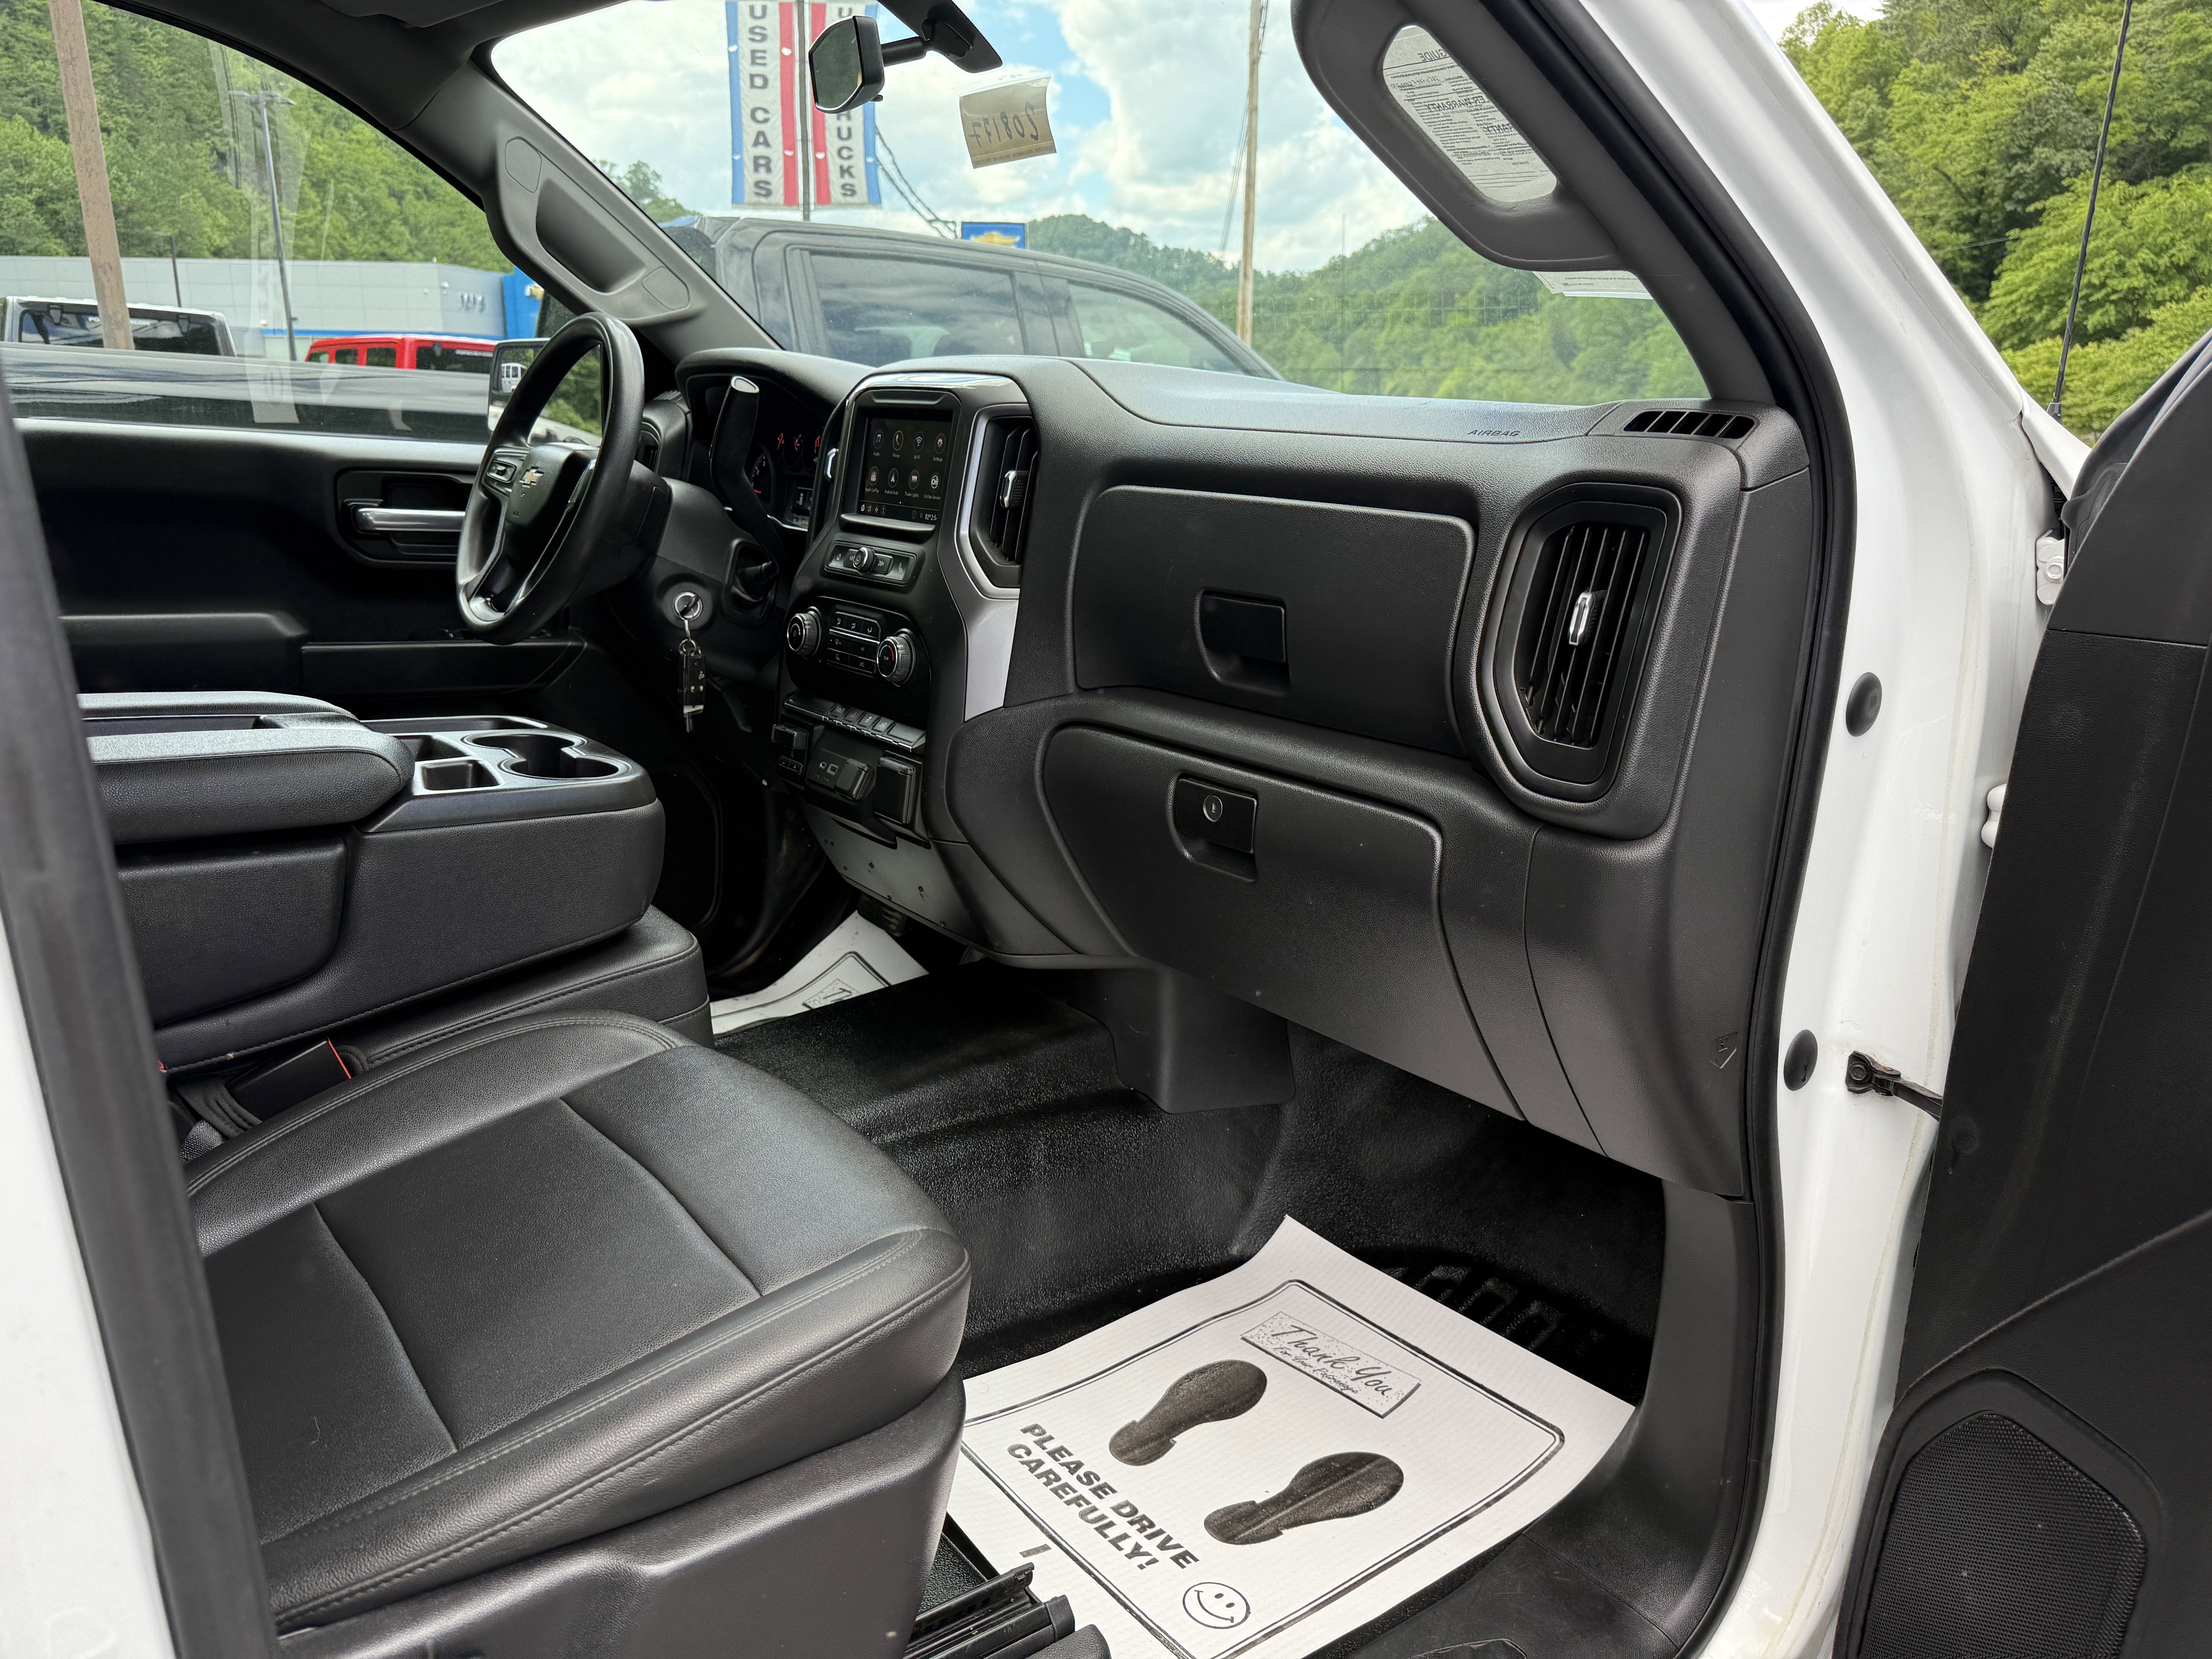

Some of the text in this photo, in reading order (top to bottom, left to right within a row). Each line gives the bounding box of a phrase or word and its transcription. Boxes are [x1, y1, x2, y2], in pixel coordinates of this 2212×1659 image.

[748, 4, 773, 198] USED CARS
[1271, 1325, 1392, 1396] Thank You
[1007, 1444, 1159, 1570] CAREFULLY!
[1020, 1423, 1200, 1569] PLEASE DRIVE
